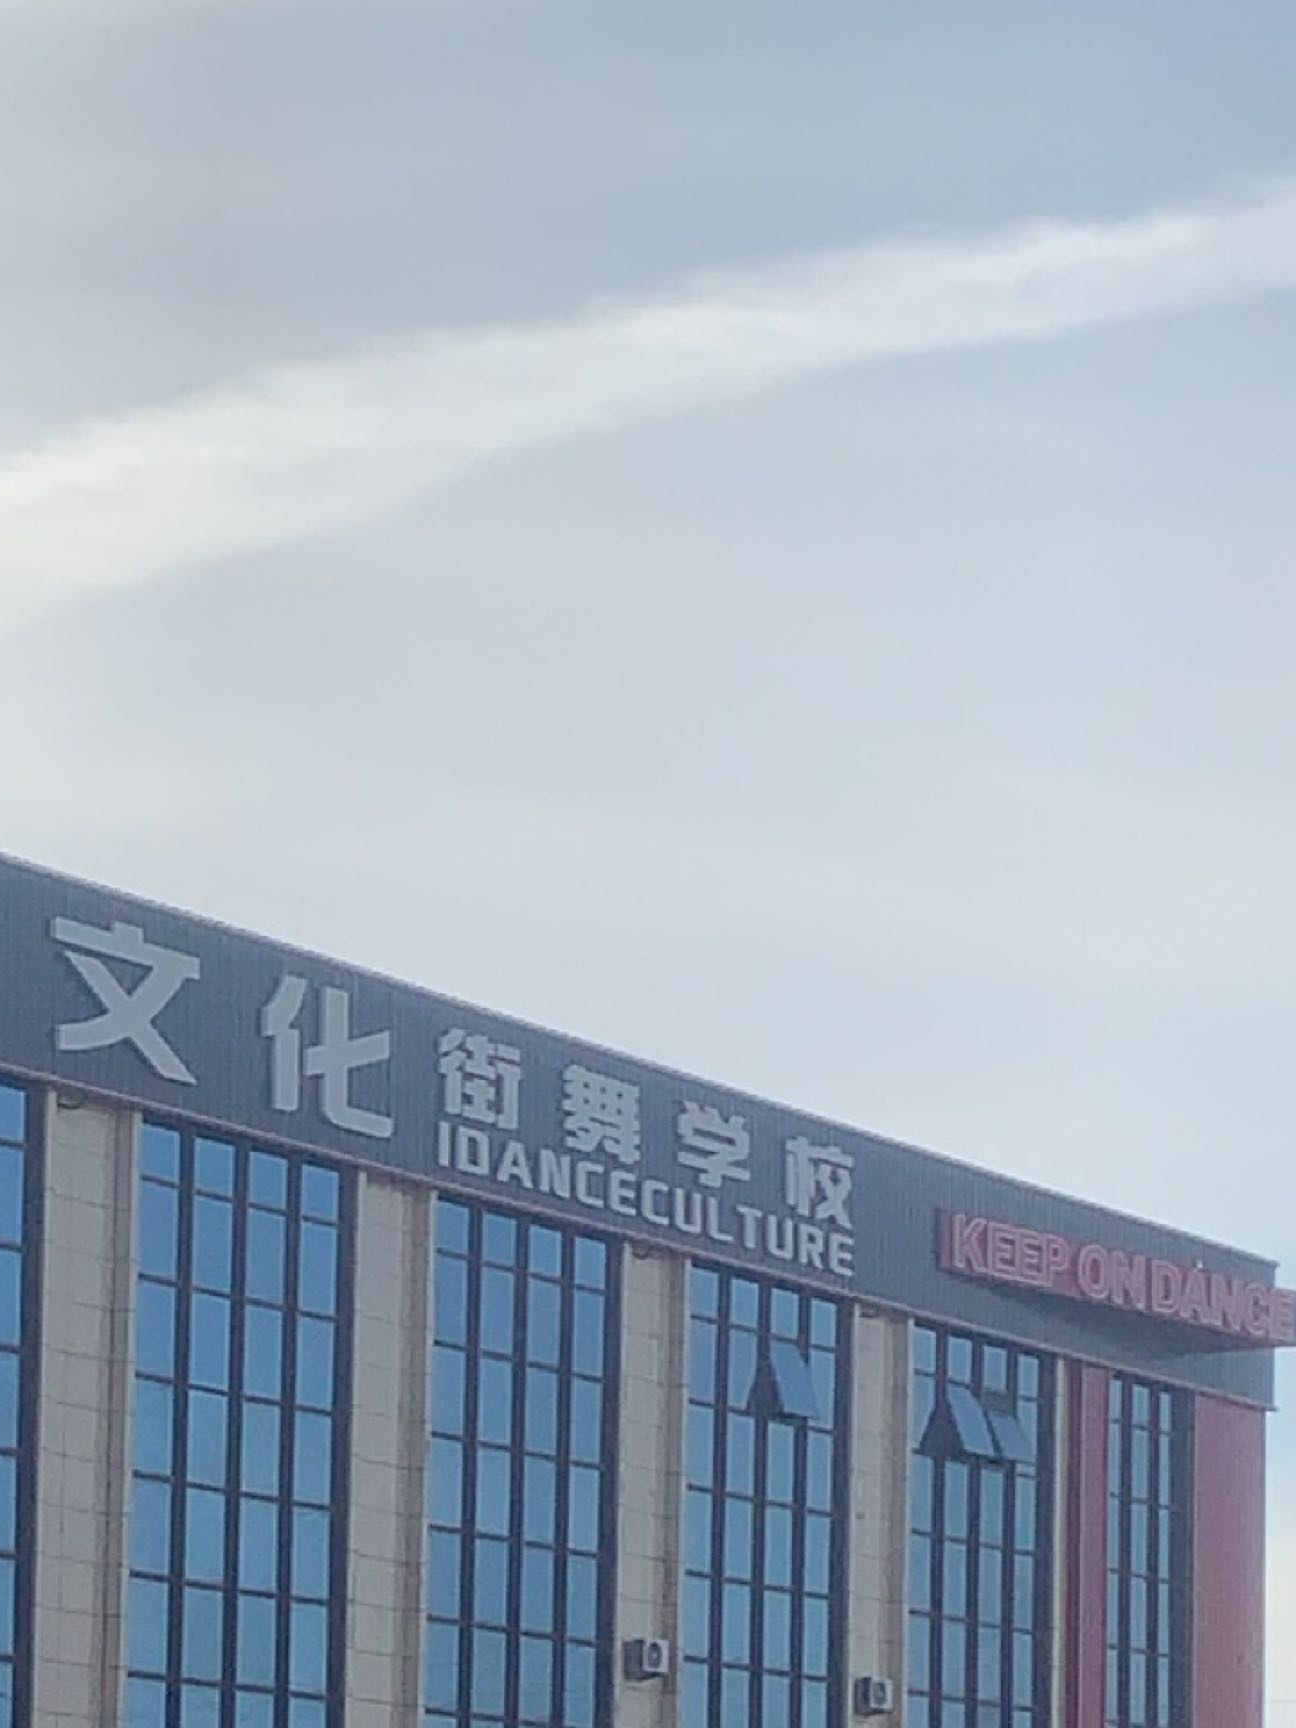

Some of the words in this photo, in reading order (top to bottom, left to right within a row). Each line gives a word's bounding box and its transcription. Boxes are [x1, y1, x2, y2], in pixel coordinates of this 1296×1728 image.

[436, 1027, 857, 1231] 街舞学校
[436, 1120, 857, 1278] IDANCECULTURE
[951, 1213, 1070, 1289] KEEP
[1076, 1243, 1146, 1314] ON
